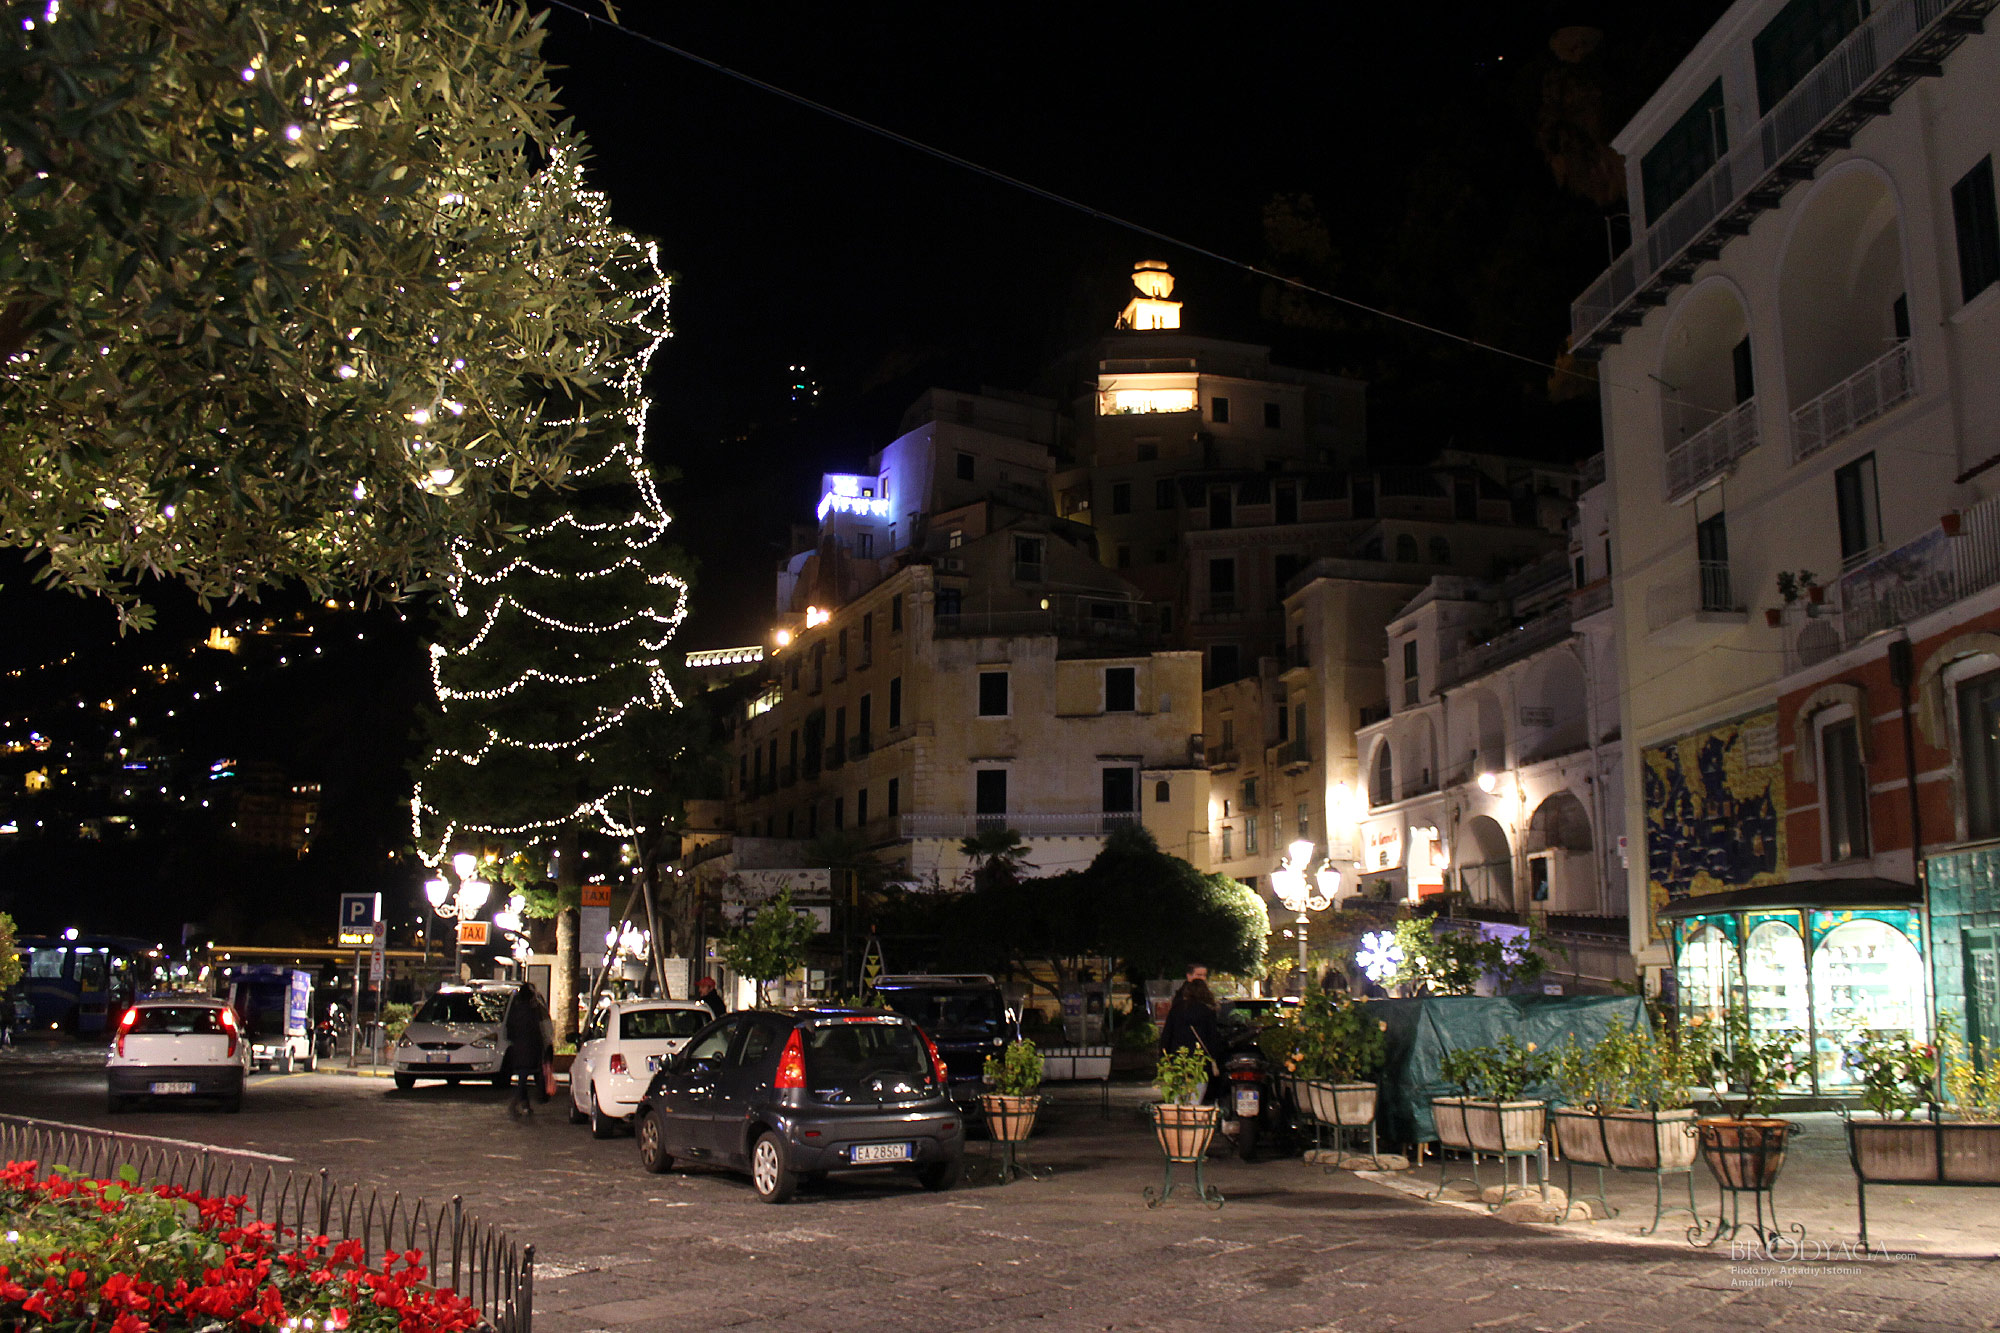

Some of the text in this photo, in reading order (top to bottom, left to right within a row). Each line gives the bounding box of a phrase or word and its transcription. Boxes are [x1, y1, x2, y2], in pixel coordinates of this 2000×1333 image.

[584, 889, 610, 902] TAXI
[351, 901, 366, 922] P
[462, 926, 484, 940] TAXI
[858, 1147, 870, 1159] EA
